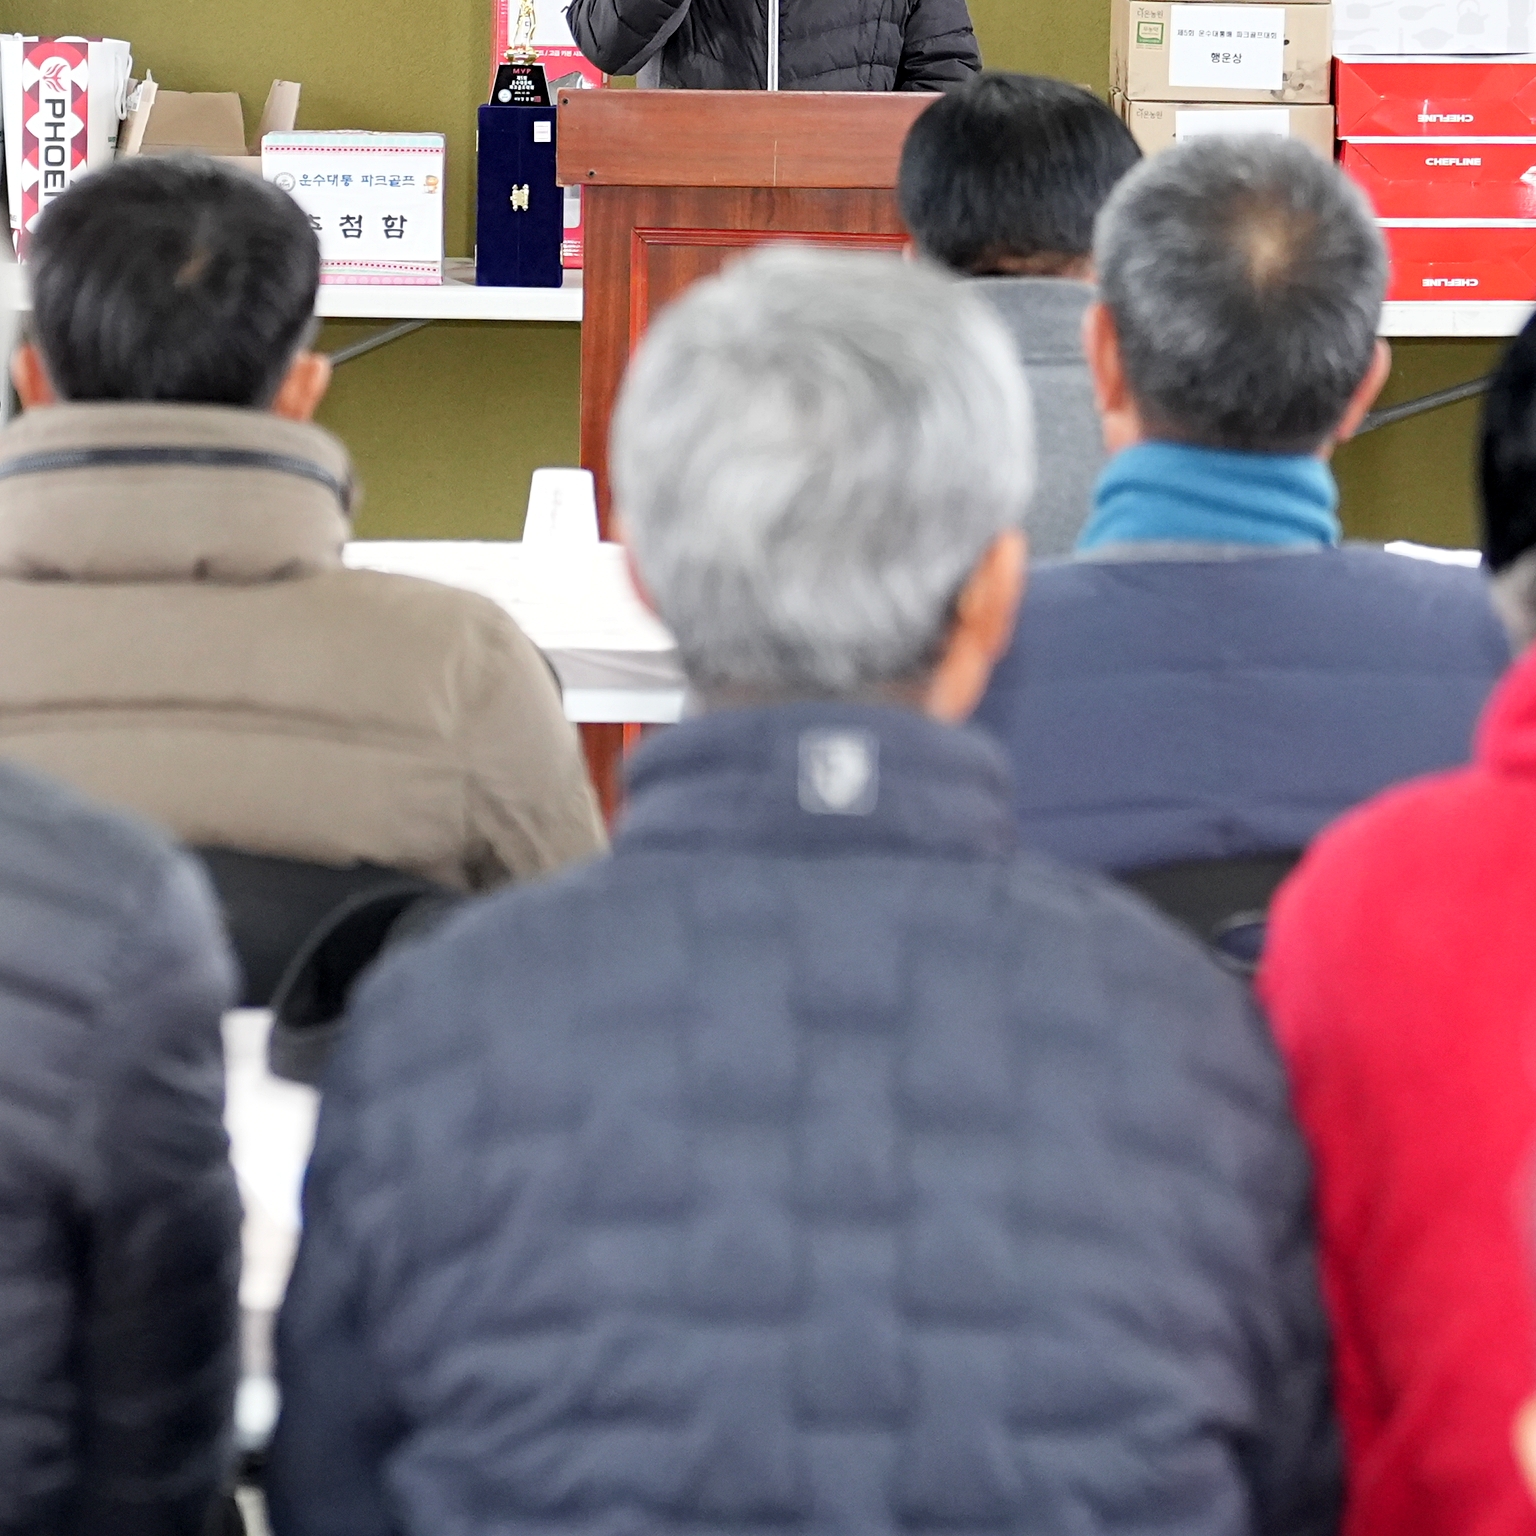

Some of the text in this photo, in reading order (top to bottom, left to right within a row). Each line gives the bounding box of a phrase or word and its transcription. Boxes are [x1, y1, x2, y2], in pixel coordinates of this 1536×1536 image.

[1210, 52, 1243, 64] 행운상
[1417, 114, 1475, 123] CHEFLINE
[1425, 157, 1482, 166] CHEFLINE
[298, 173, 416, 187] 운수대통 파크골프
[1422, 278, 1479, 287] CHEFLINE
